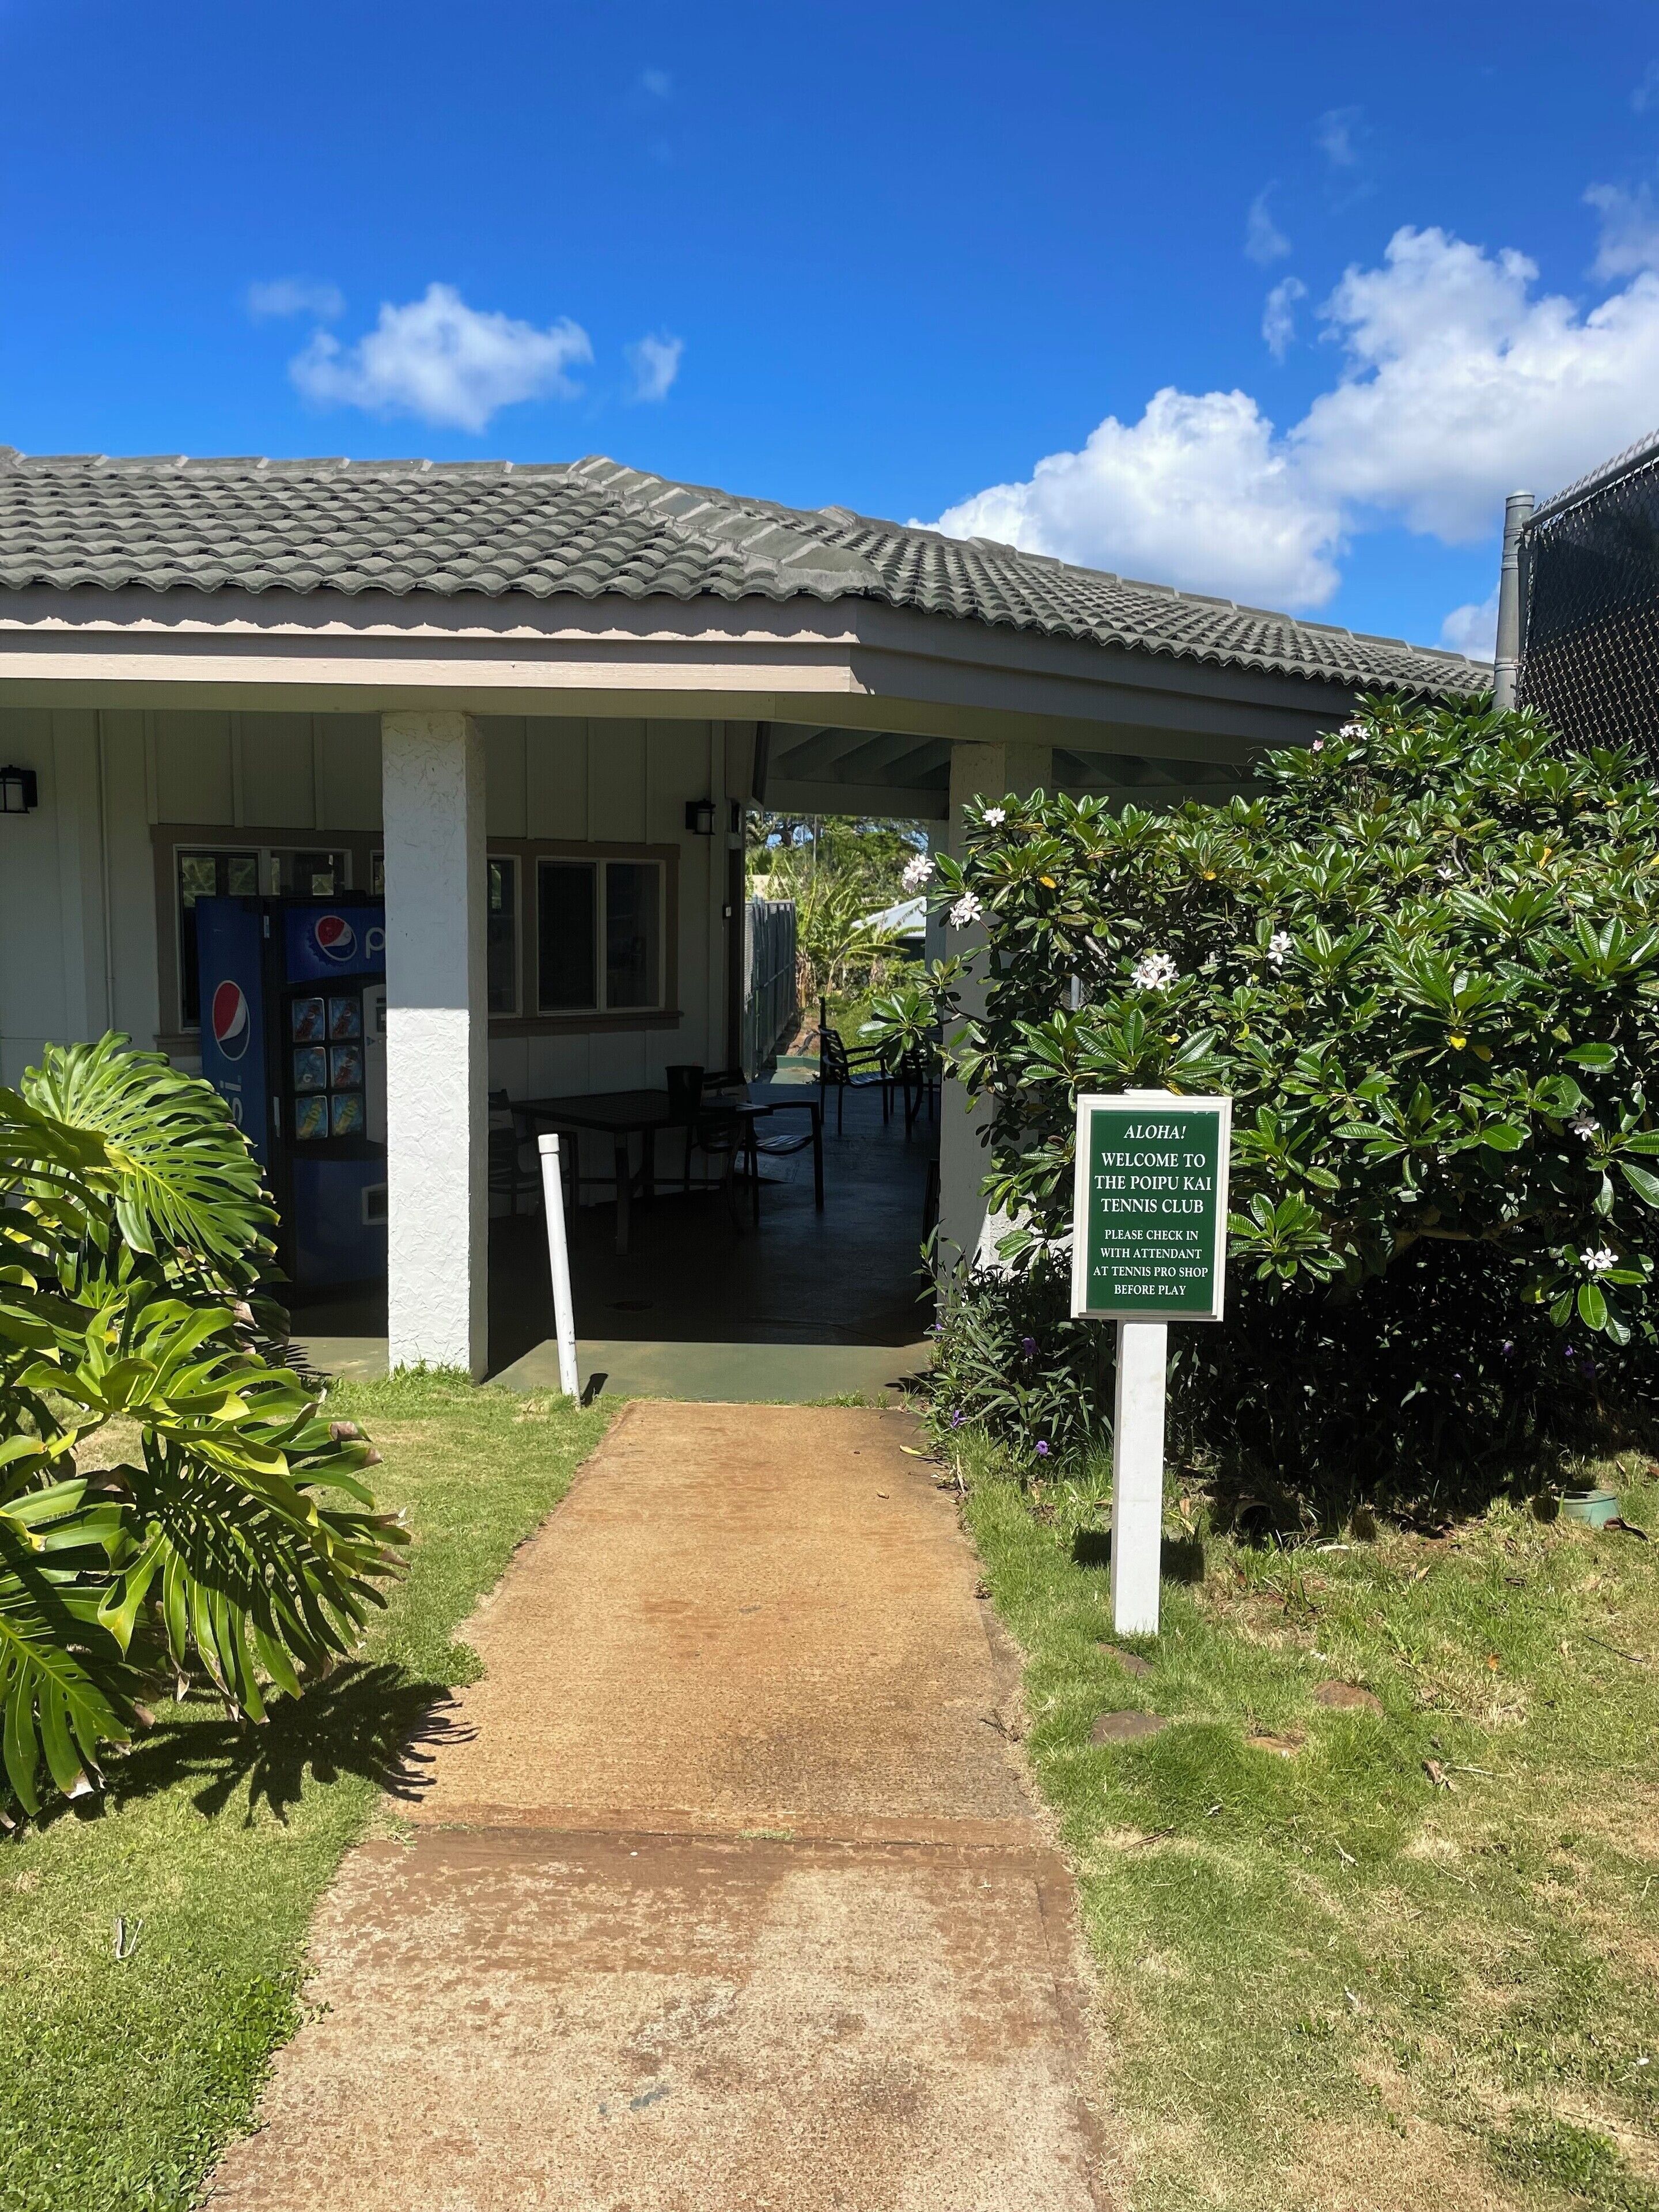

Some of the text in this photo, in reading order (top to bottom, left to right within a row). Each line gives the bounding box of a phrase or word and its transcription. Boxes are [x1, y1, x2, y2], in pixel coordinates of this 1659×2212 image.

[1123, 1124, 1187, 1139] ALOHA!
[1101, 1152, 1206, 1168] WELCOME TO
[1094, 1175, 1212, 1191] THE POIPU KAI
[1100, 1198, 1204, 1214] TENNIS CLUB
[1104, 1229, 1199, 1241] PLEASE CHECK IN
[1100, 1248, 1202, 1259] WITH ATTENDANT
[1093, 1266, 1209, 1278] AT TENNIS PRO SHOP
[1114, 1284, 1187, 1296] BEFORE PLAY
